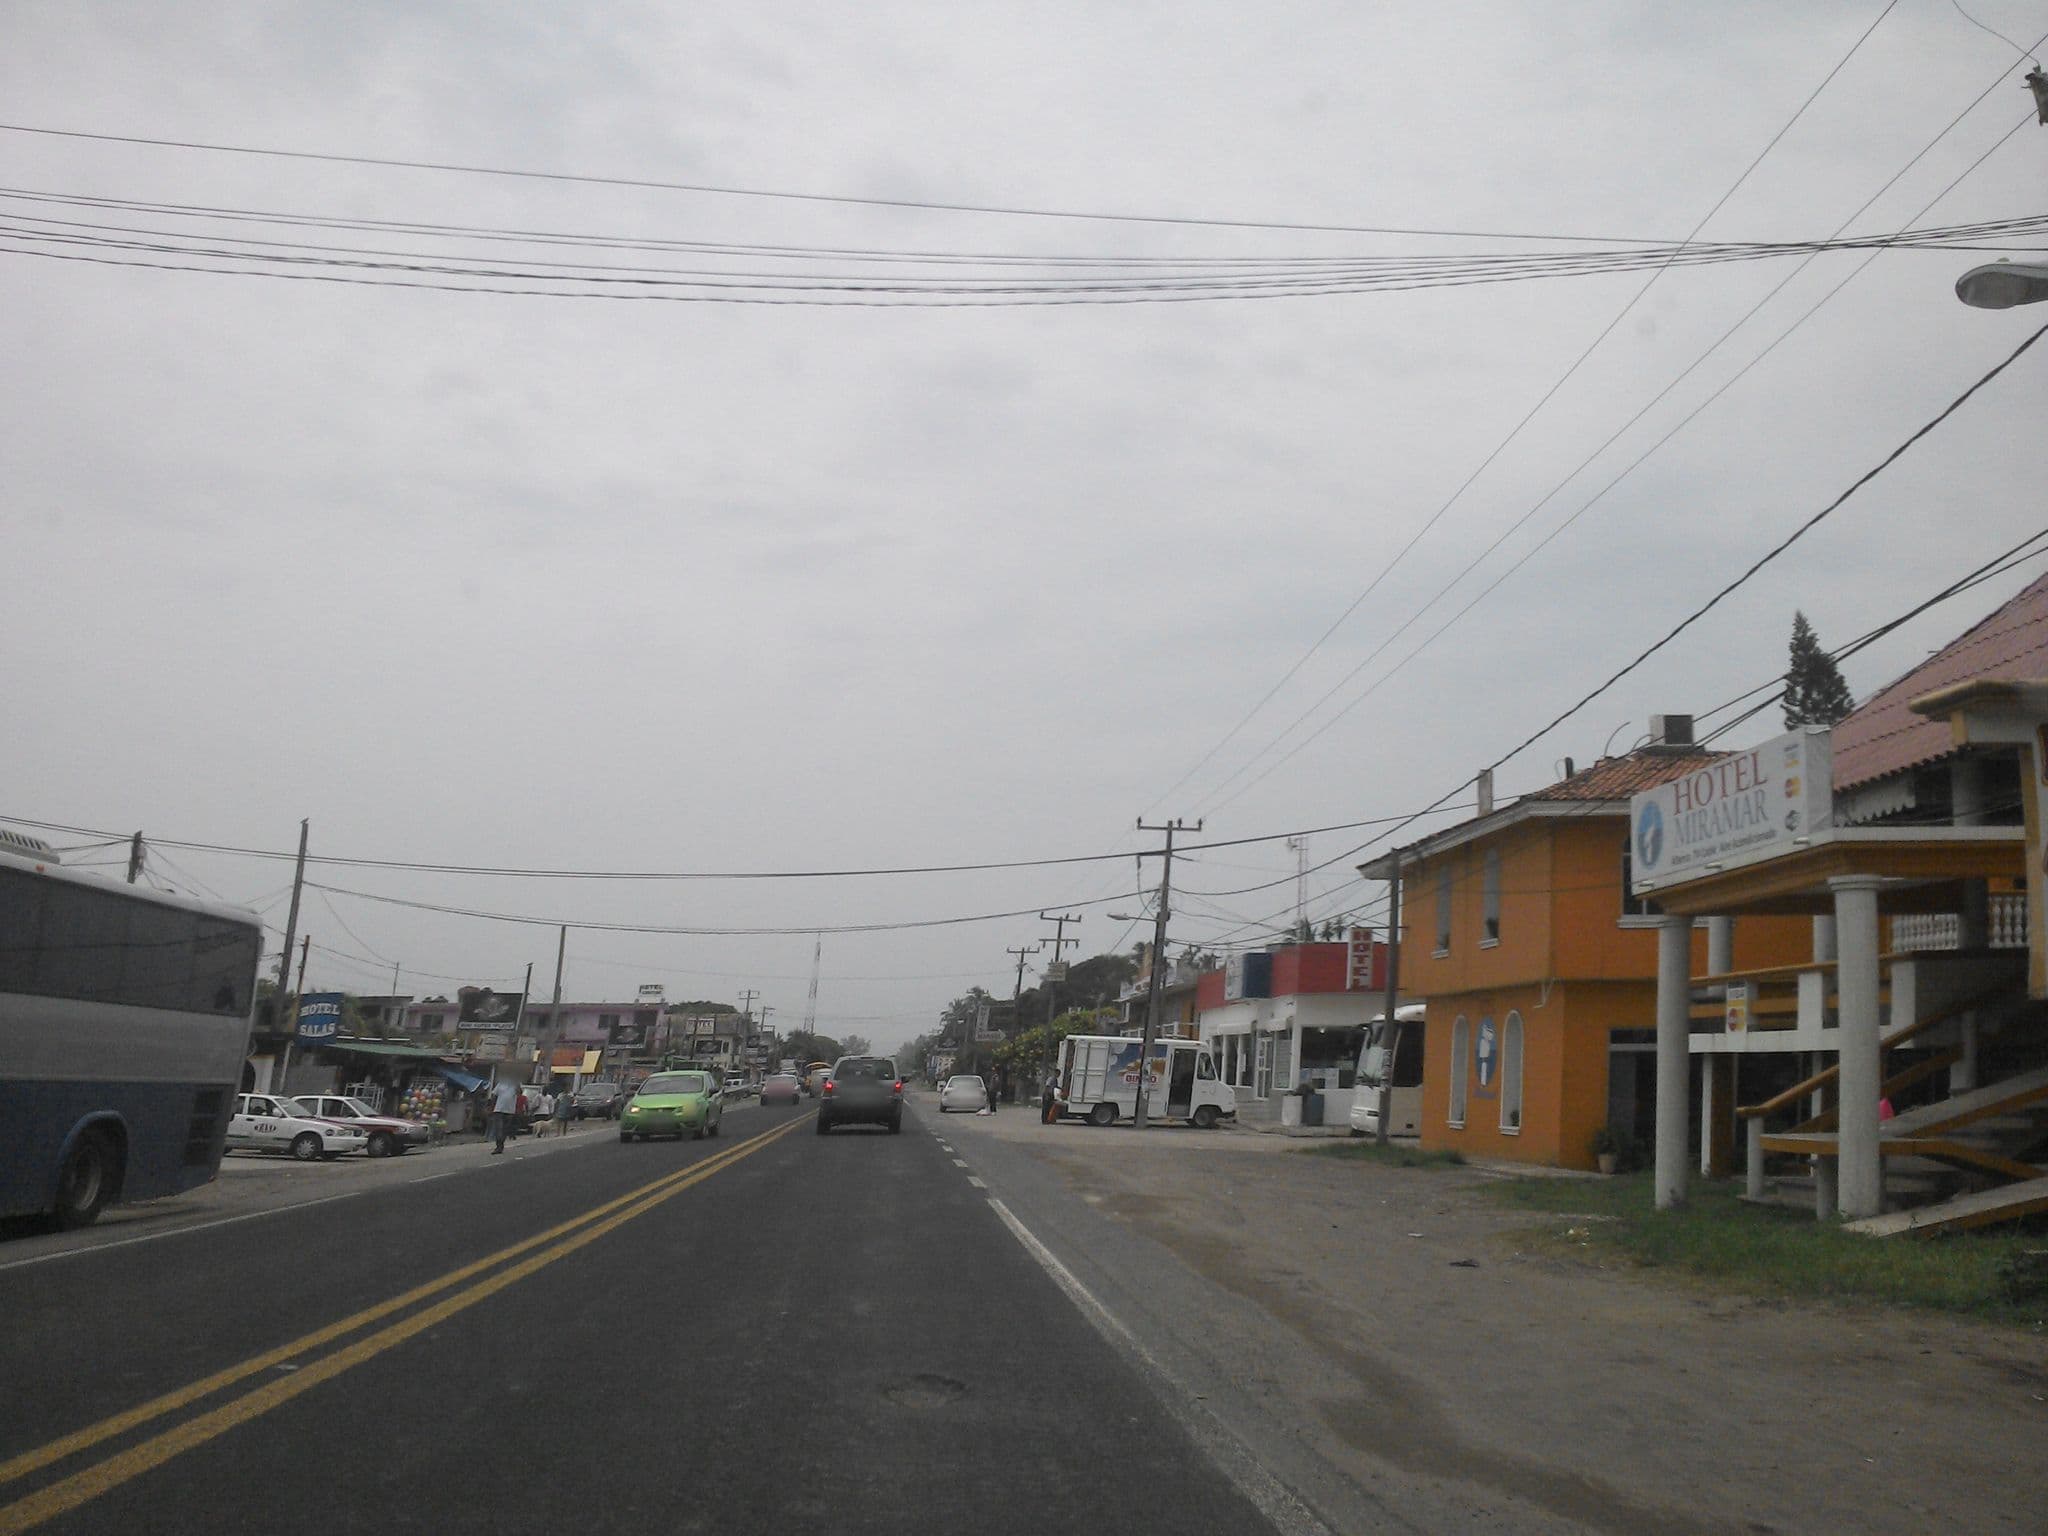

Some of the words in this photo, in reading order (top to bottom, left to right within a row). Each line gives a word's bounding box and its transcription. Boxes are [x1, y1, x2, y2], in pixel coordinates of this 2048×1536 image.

[1673, 751, 1768, 816] HOTEL
[1674, 789, 1769, 846] MIRAMAR
[1352, 930, 1373, 992] HOTEL
[299, 1022, 336, 1037] SALAS
[300, 1003, 340, 1017] HOTEL
